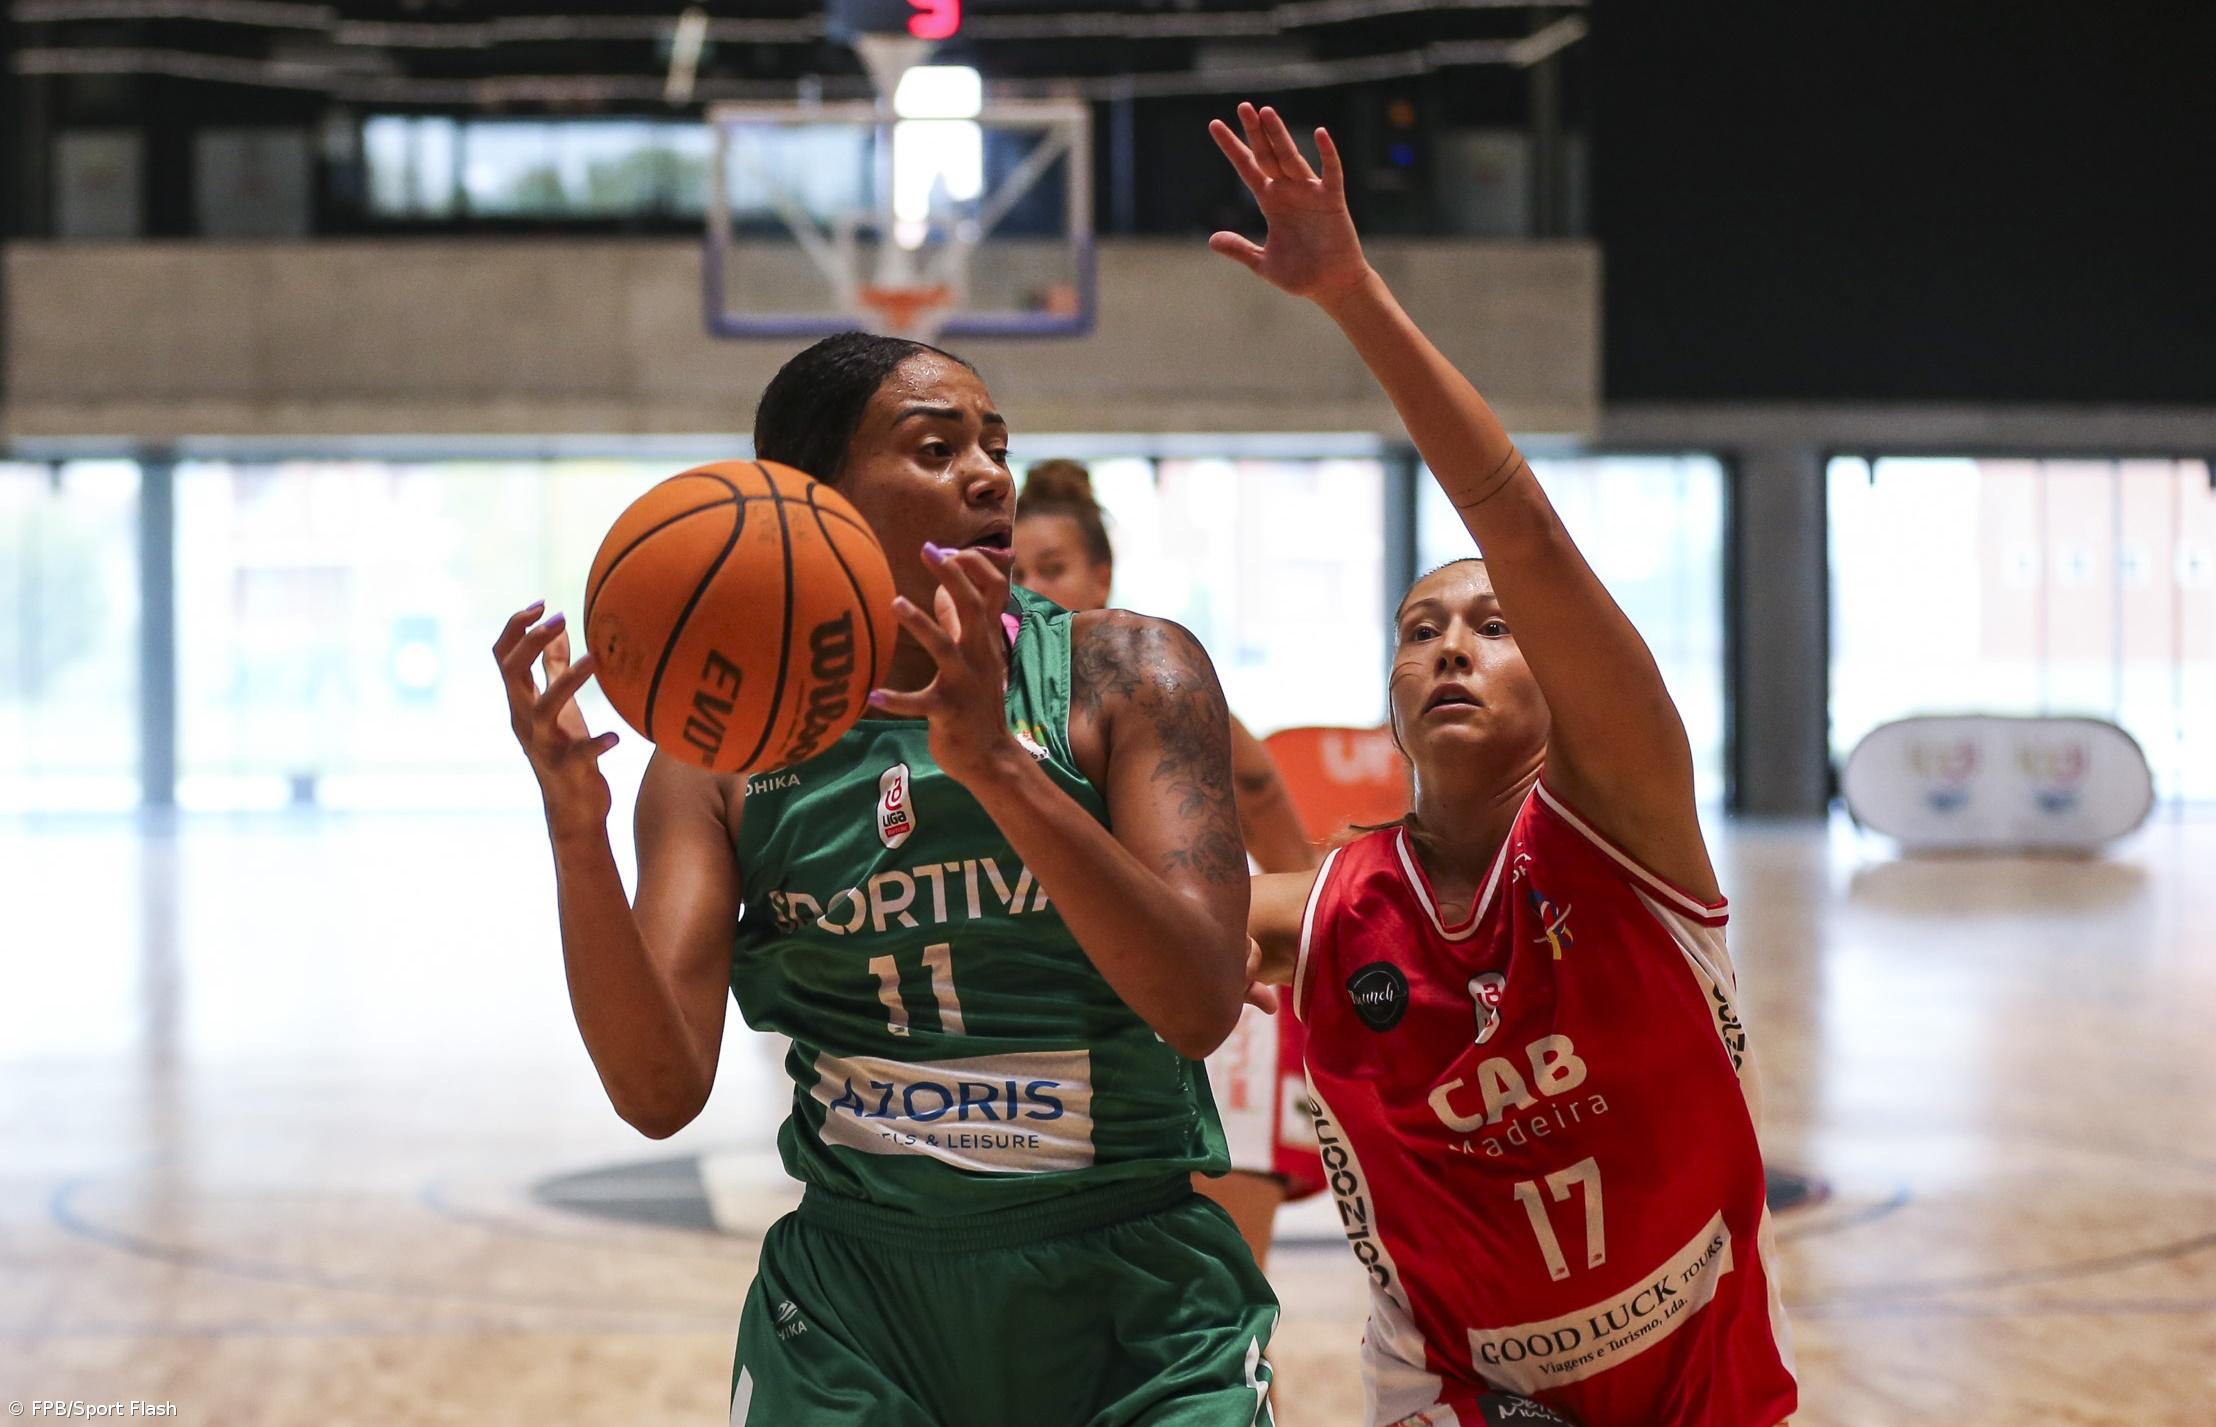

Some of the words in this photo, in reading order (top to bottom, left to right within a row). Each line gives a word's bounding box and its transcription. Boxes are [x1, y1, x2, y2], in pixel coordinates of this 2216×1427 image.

[682, 650, 743, 755] EVO
[772, 609, 856, 768] Wilso
[868, 943, 967, 1037] 11
[830, 1076, 1064, 1122] AZORIS
[1428, 1034, 1587, 1133] CAB
[1448, 1094, 1609, 1158] adeira
[926, 1134, 939, 1147] &
[948, 1134, 1040, 1149] LEISURE
[1514, 1157, 1606, 1282] 17
[1481, 1328, 1582, 1366] GOOD
[1588, 1275, 1677, 1340] LUCK
[1680, 1236, 1723, 1283] TOURS
[1538, 1351, 1594, 1375] Viagens
[1597, 1348, 1605, 1358] e
[1606, 1319, 1664, 1352] Turismo,
[1664, 1298, 1688, 1320] Lda.
